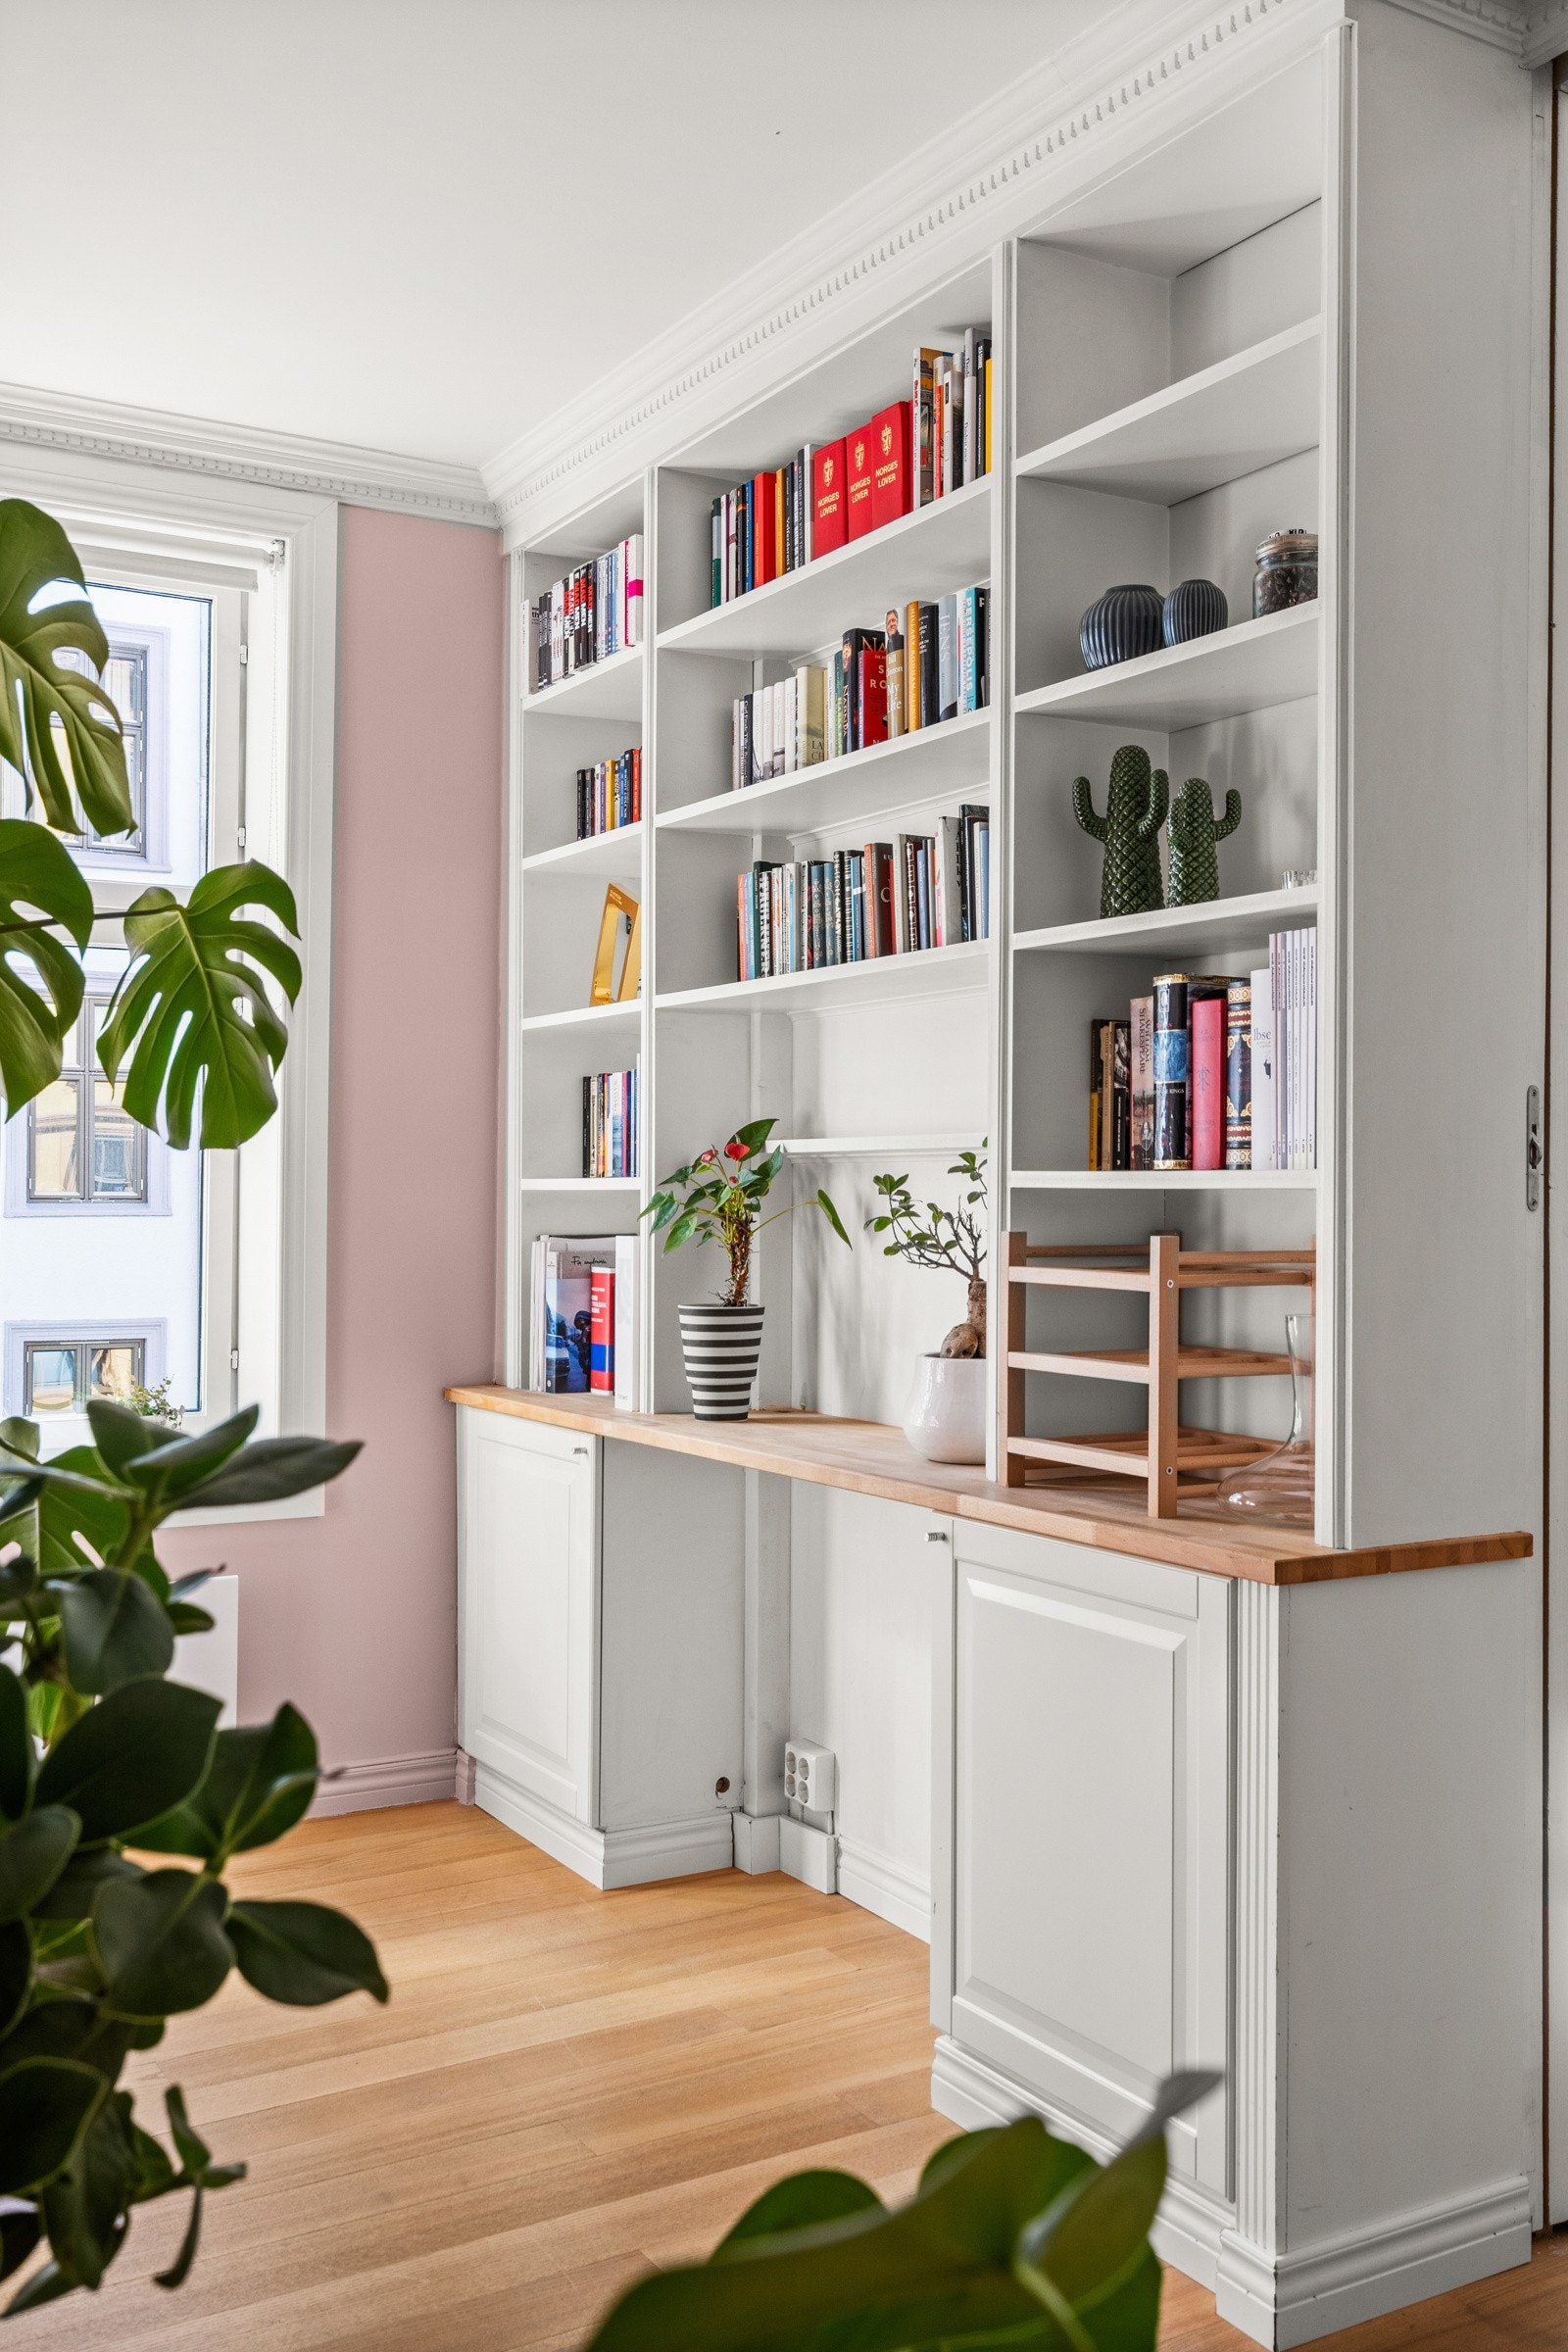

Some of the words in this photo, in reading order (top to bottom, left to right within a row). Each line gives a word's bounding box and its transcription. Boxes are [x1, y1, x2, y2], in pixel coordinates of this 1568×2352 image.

[875, 461, 899, 477] NORGES
[850, 477, 871, 493] NORGES
[877, 473, 897, 488] LOVER
[817, 492, 840, 508] NORGES
[852, 489, 869, 504] LOVER
[819, 505, 838, 518] LOVER
[878, 664, 885, 674] S
[870, 679, 886, 690] RO
[811, 752, 824, 761] CH
[1253, 1027, 1271, 1042] Ibse
